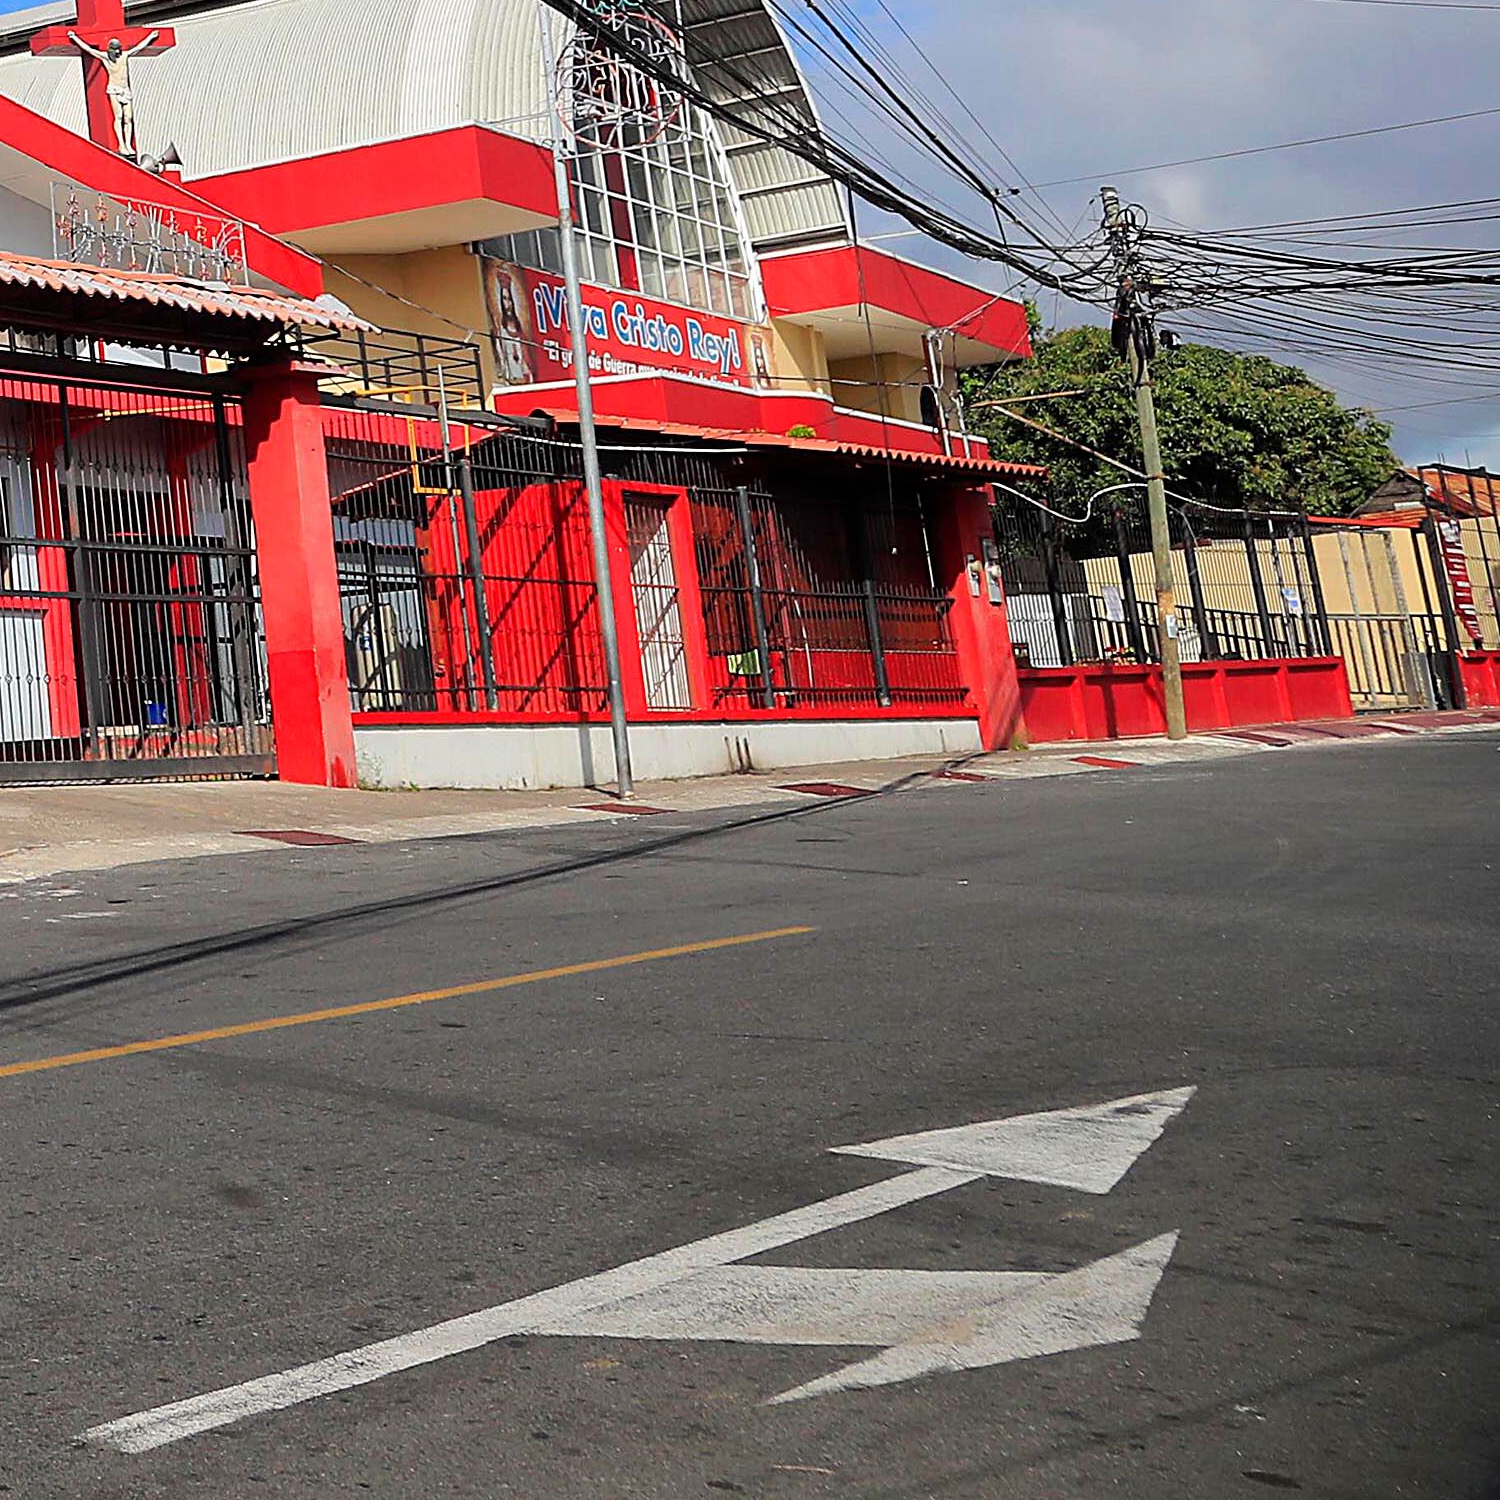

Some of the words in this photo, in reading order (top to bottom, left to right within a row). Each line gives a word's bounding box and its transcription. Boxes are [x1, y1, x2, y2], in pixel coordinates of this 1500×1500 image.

[533, 282, 608, 339] ¡Va
[612, 300, 683, 356] Cristo
[685, 317, 741, 376] Rey!
[588, 350, 602, 370] de
[602, 352, 637, 374] Guerra
